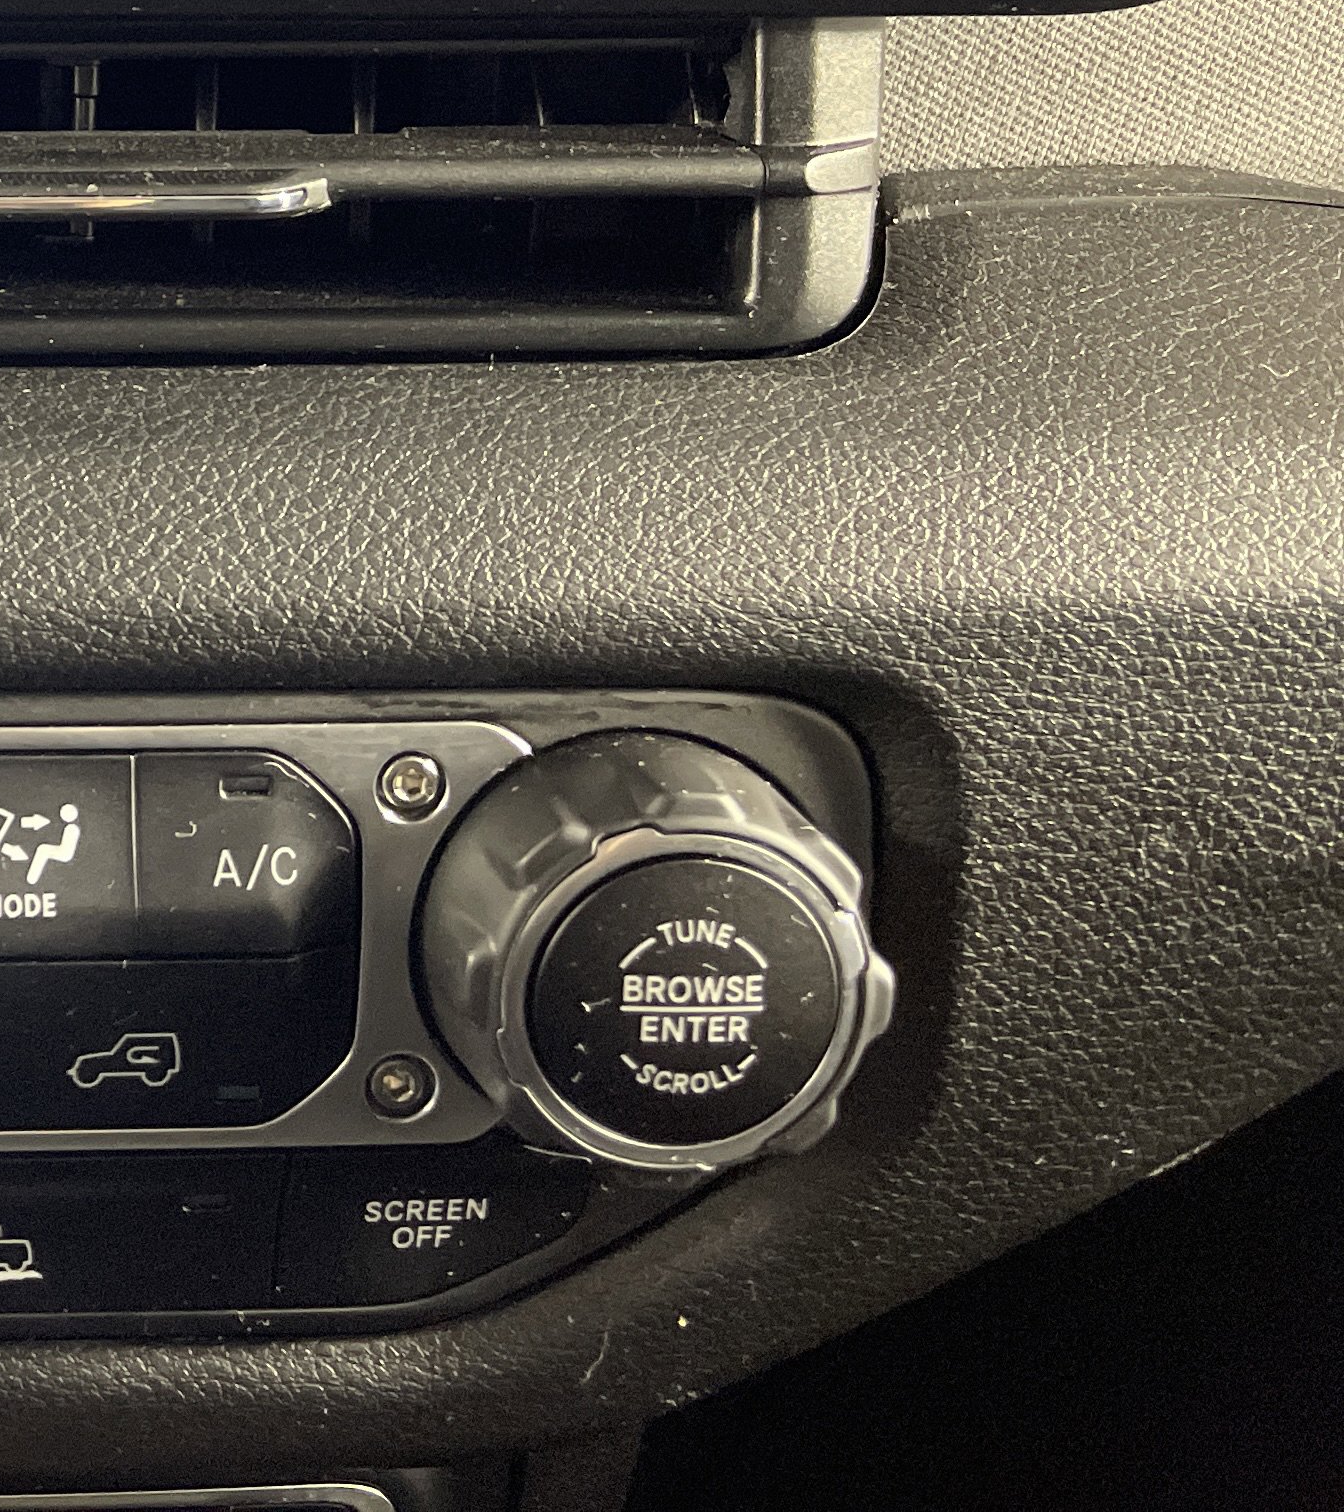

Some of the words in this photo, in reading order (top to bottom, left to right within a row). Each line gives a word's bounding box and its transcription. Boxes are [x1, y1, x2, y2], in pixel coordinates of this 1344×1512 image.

[212, 845, 300, 891] A/C
[655, 918, 736, 949] TUNE
[621, 974, 764, 1004] BROWSE
[639, 1014, 749, 1043] ENTER
[634, 1062, 744, 1095] SCROLL
[364, 1198, 487, 1223] SCREEN
[391, 1225, 452, 1249] OFF
